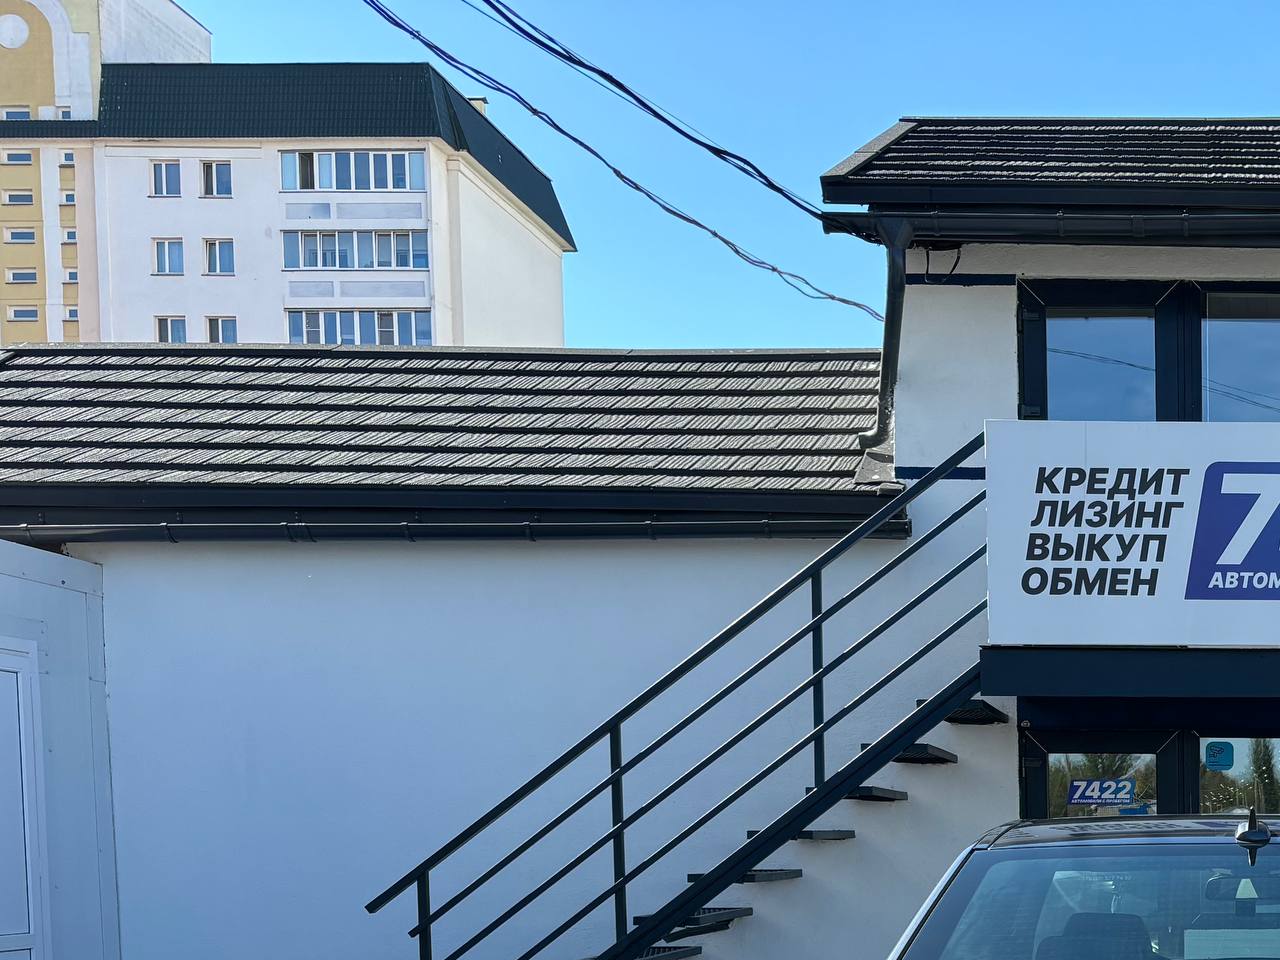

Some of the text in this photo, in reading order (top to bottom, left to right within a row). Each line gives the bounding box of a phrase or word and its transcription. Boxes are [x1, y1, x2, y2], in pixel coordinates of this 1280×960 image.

[1034, 466, 1190, 500] КРЕДИТ
[1030, 500, 1184, 529] ЛИЗИНГ
[1025, 533, 1168, 563] ВЫКУП
[1020, 567, 1157, 597] ОБМЕН
[1072, 780, 1132, 799] 7422
